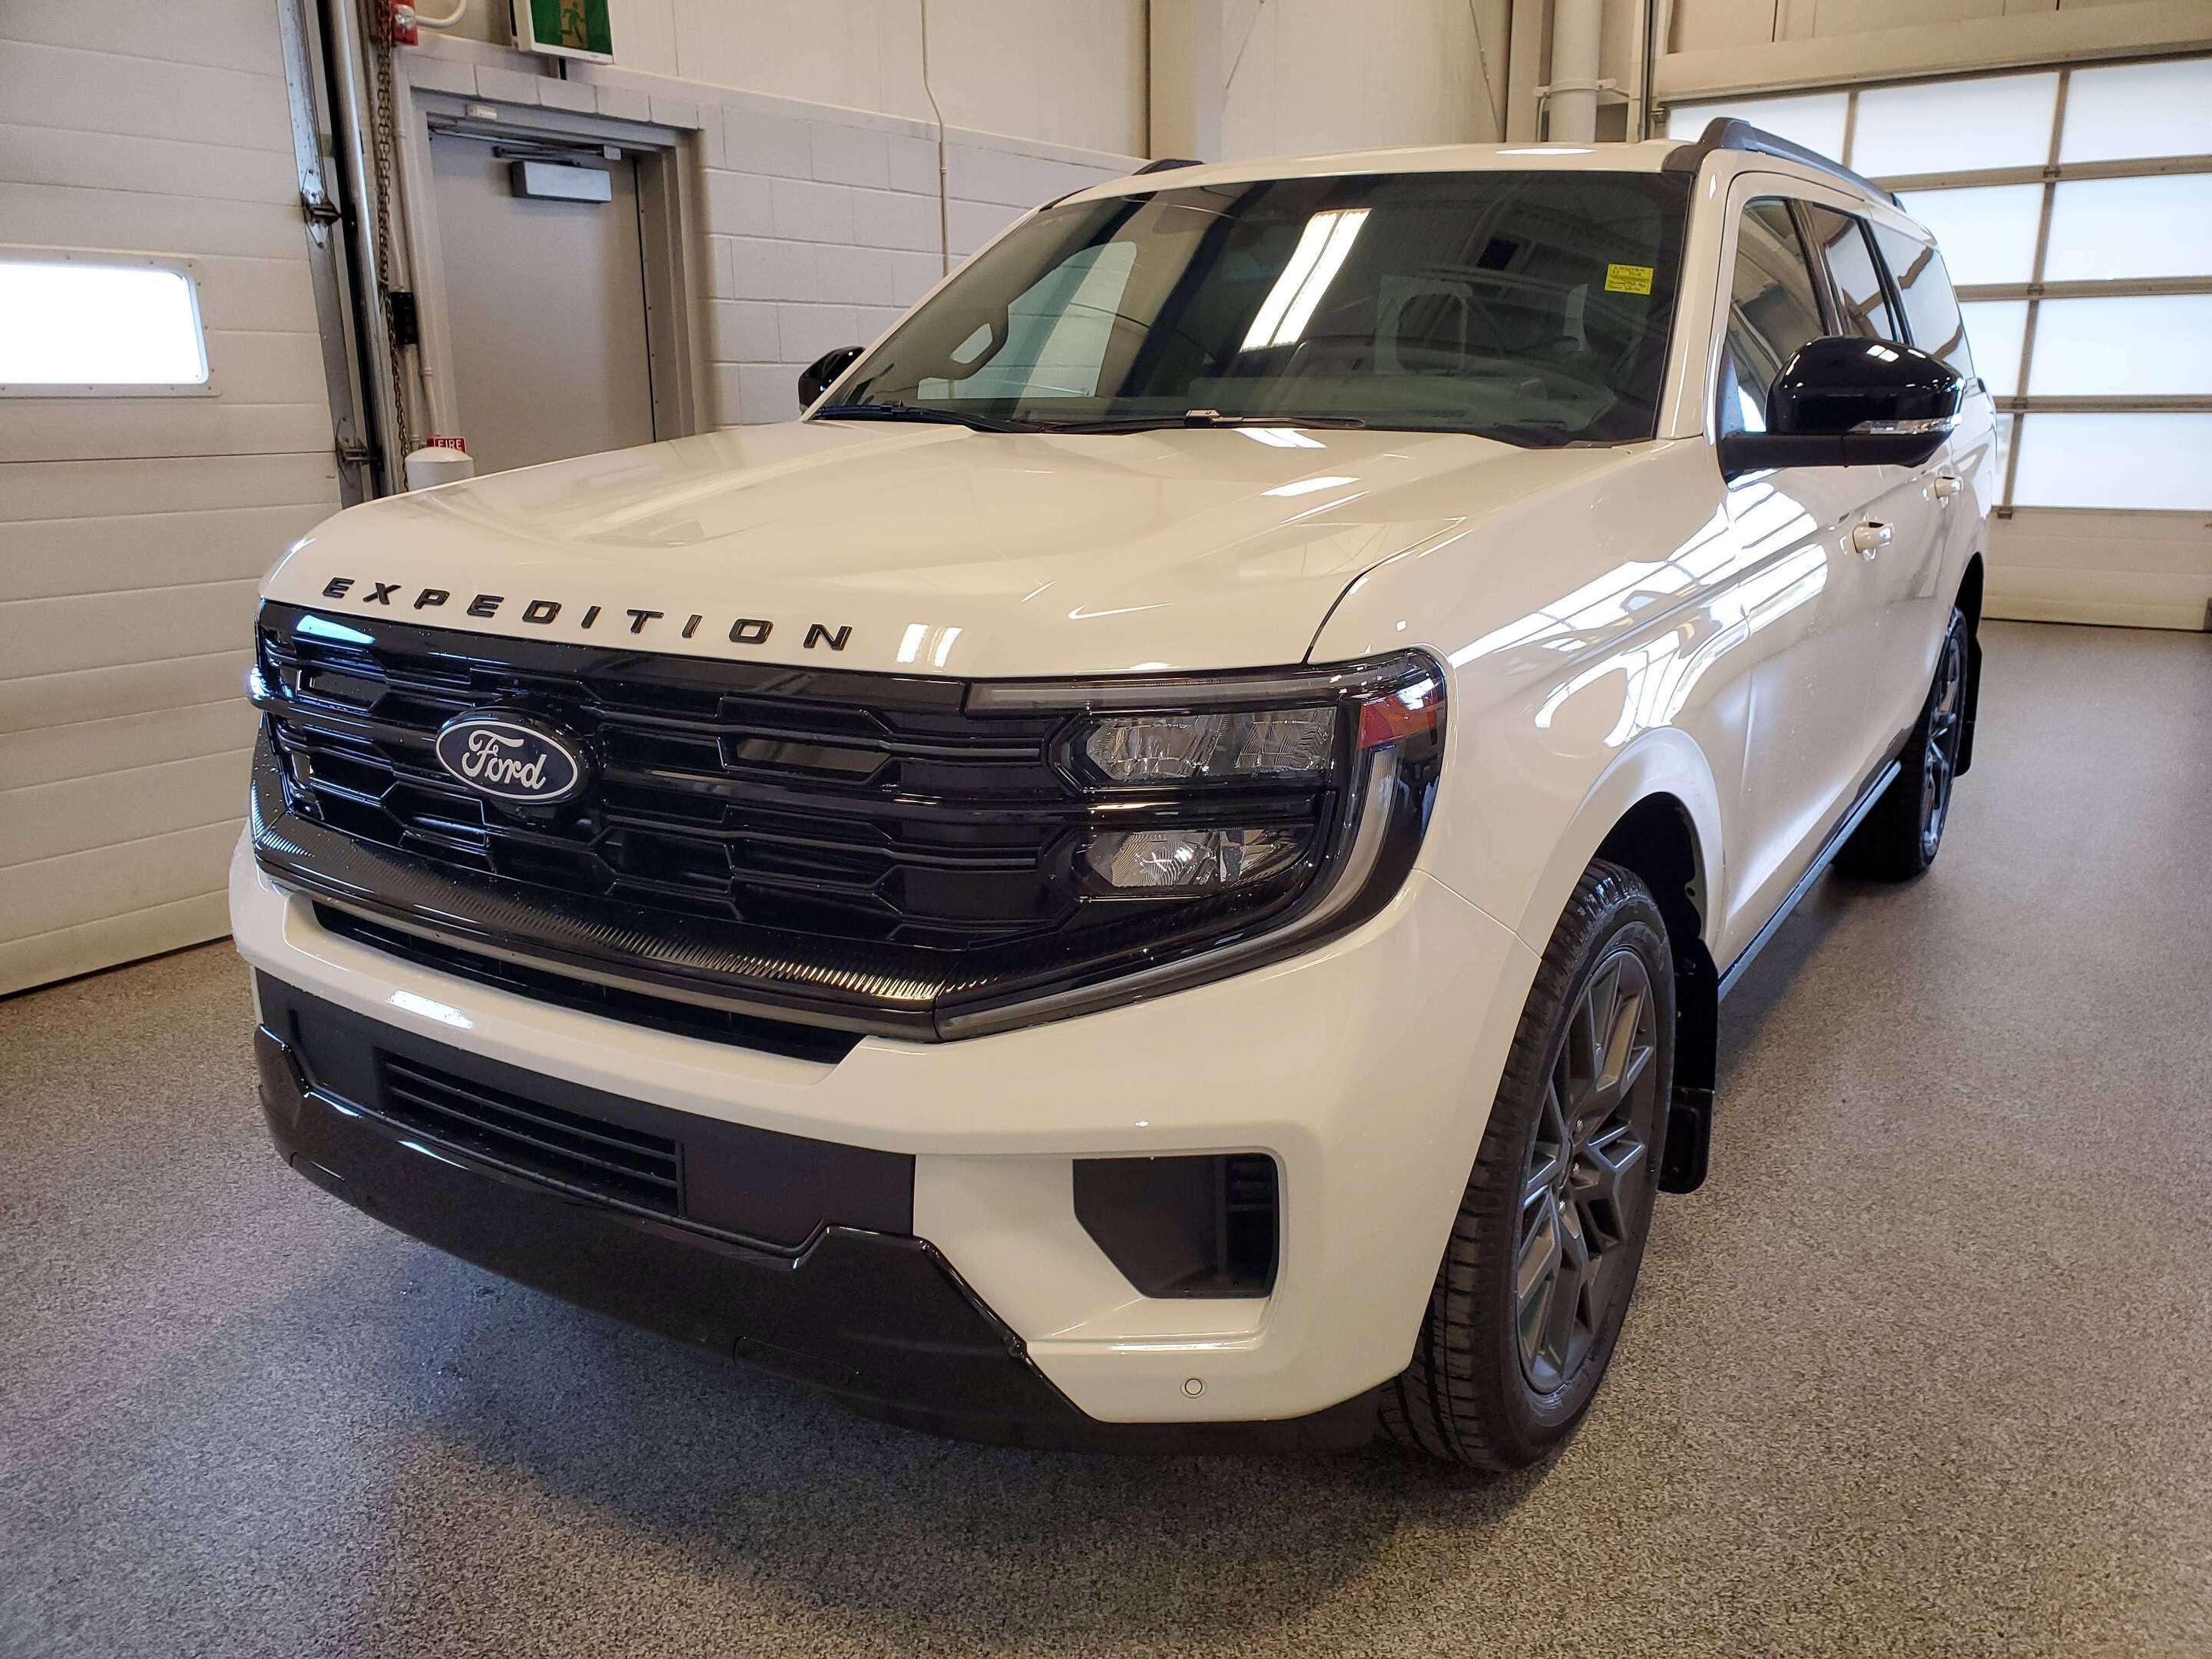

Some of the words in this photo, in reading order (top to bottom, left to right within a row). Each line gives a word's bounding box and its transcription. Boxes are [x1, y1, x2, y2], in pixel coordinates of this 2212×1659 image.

[438, 439, 462, 449] FIRE
[322, 577, 853, 651] EXPEDITION
[462, 730, 548, 790] Ford
